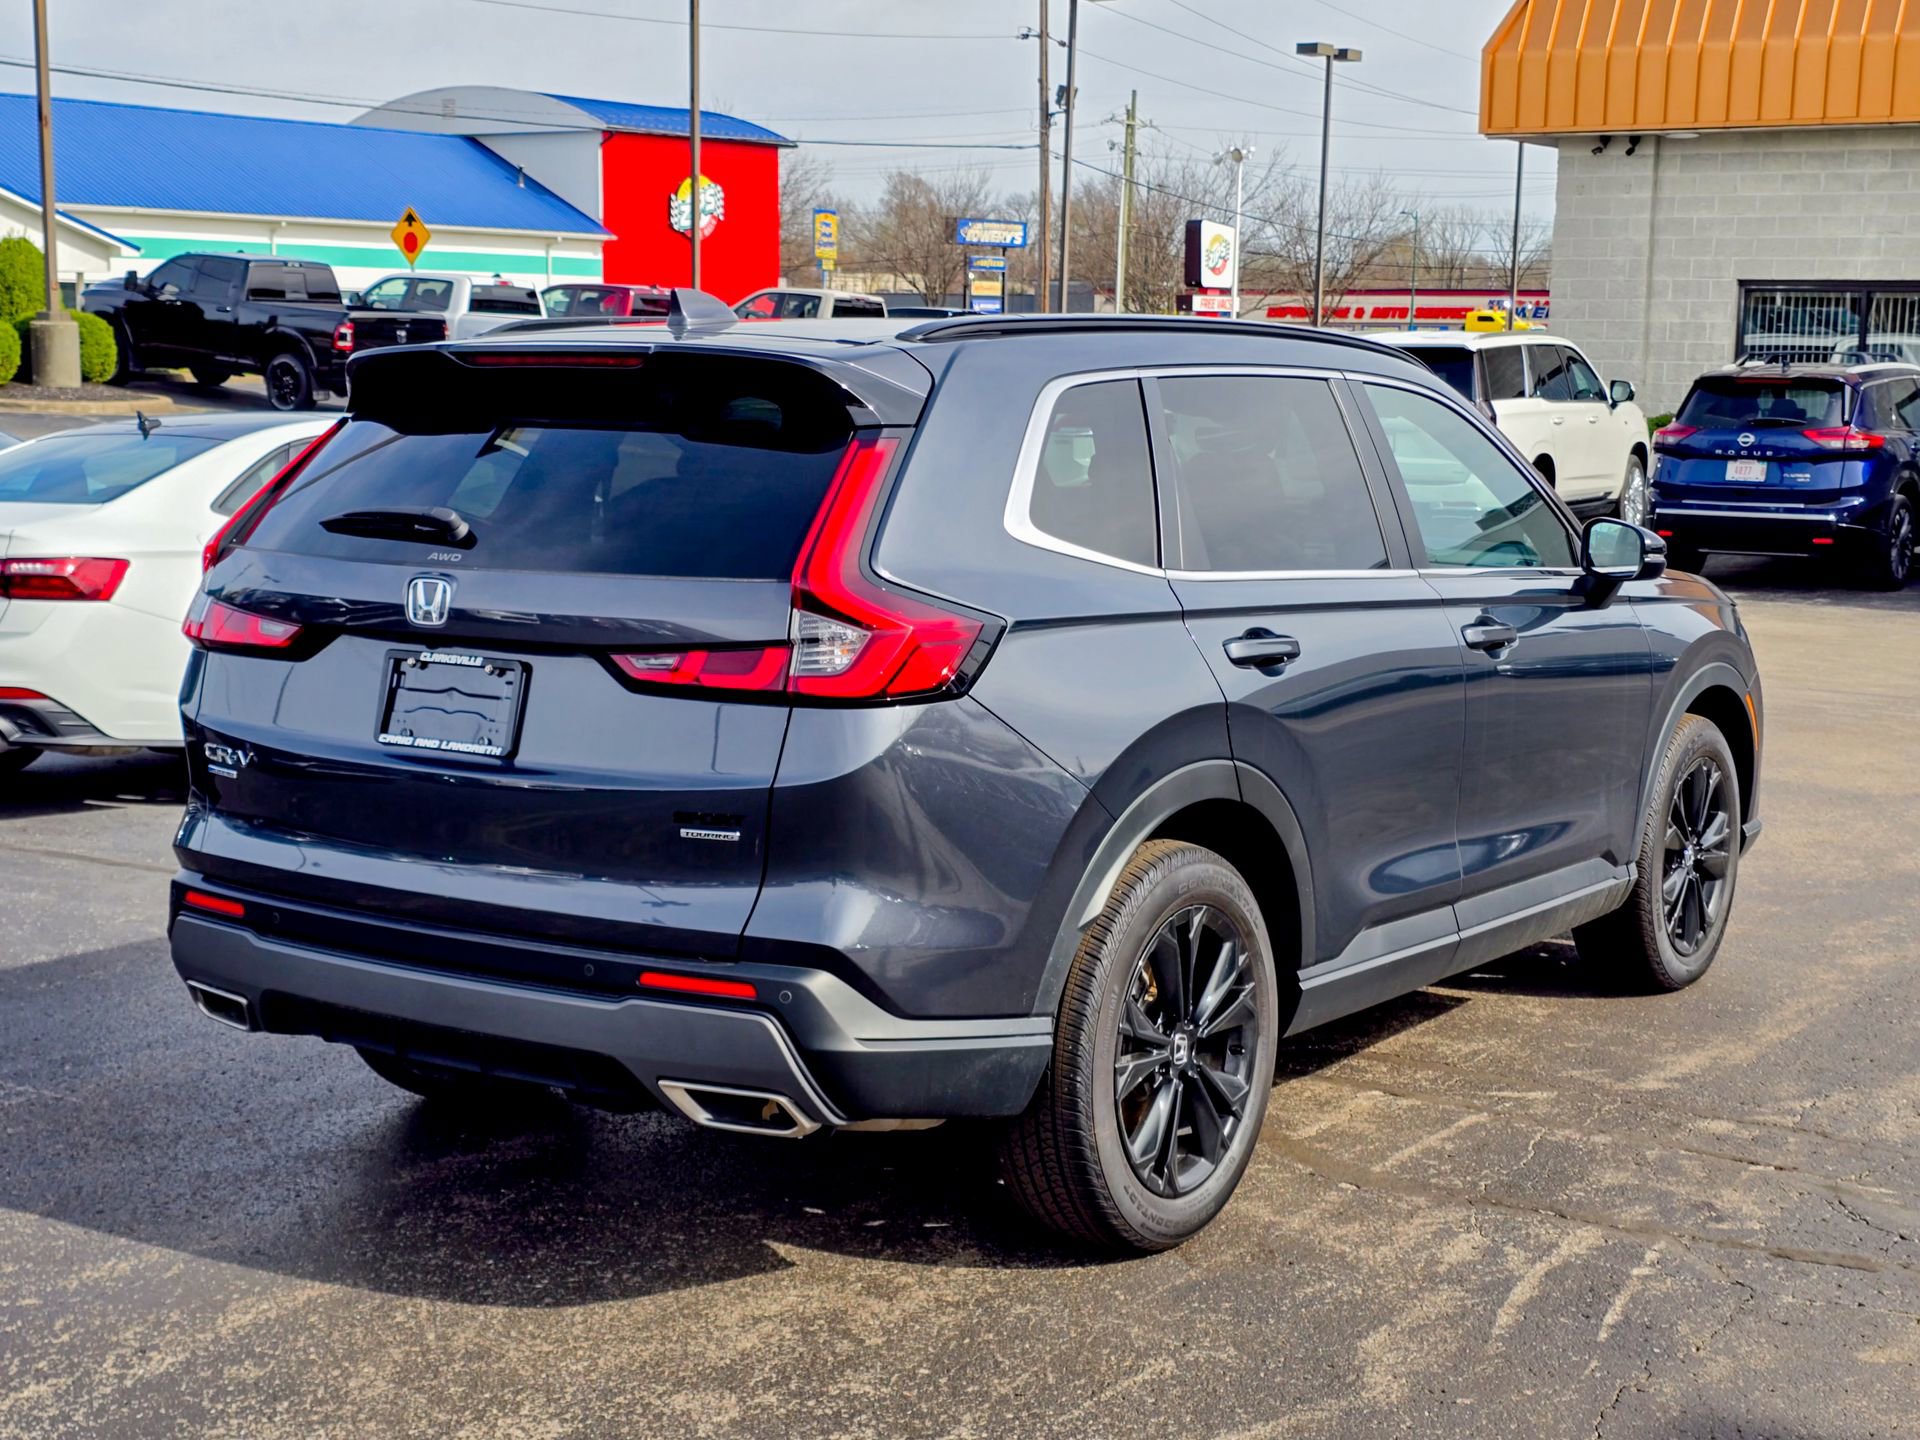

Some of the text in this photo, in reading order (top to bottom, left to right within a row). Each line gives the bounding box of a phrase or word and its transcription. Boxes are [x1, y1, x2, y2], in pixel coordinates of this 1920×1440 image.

[1714, 448, 1774, 457] ROGUE
[426, 551, 462, 562] AWD
[419, 652, 484, 666] CLARKSVILLE
[378, 733, 502, 756] CRAIG AND LANDRETH
[684, 830, 736, 840] TOURING
